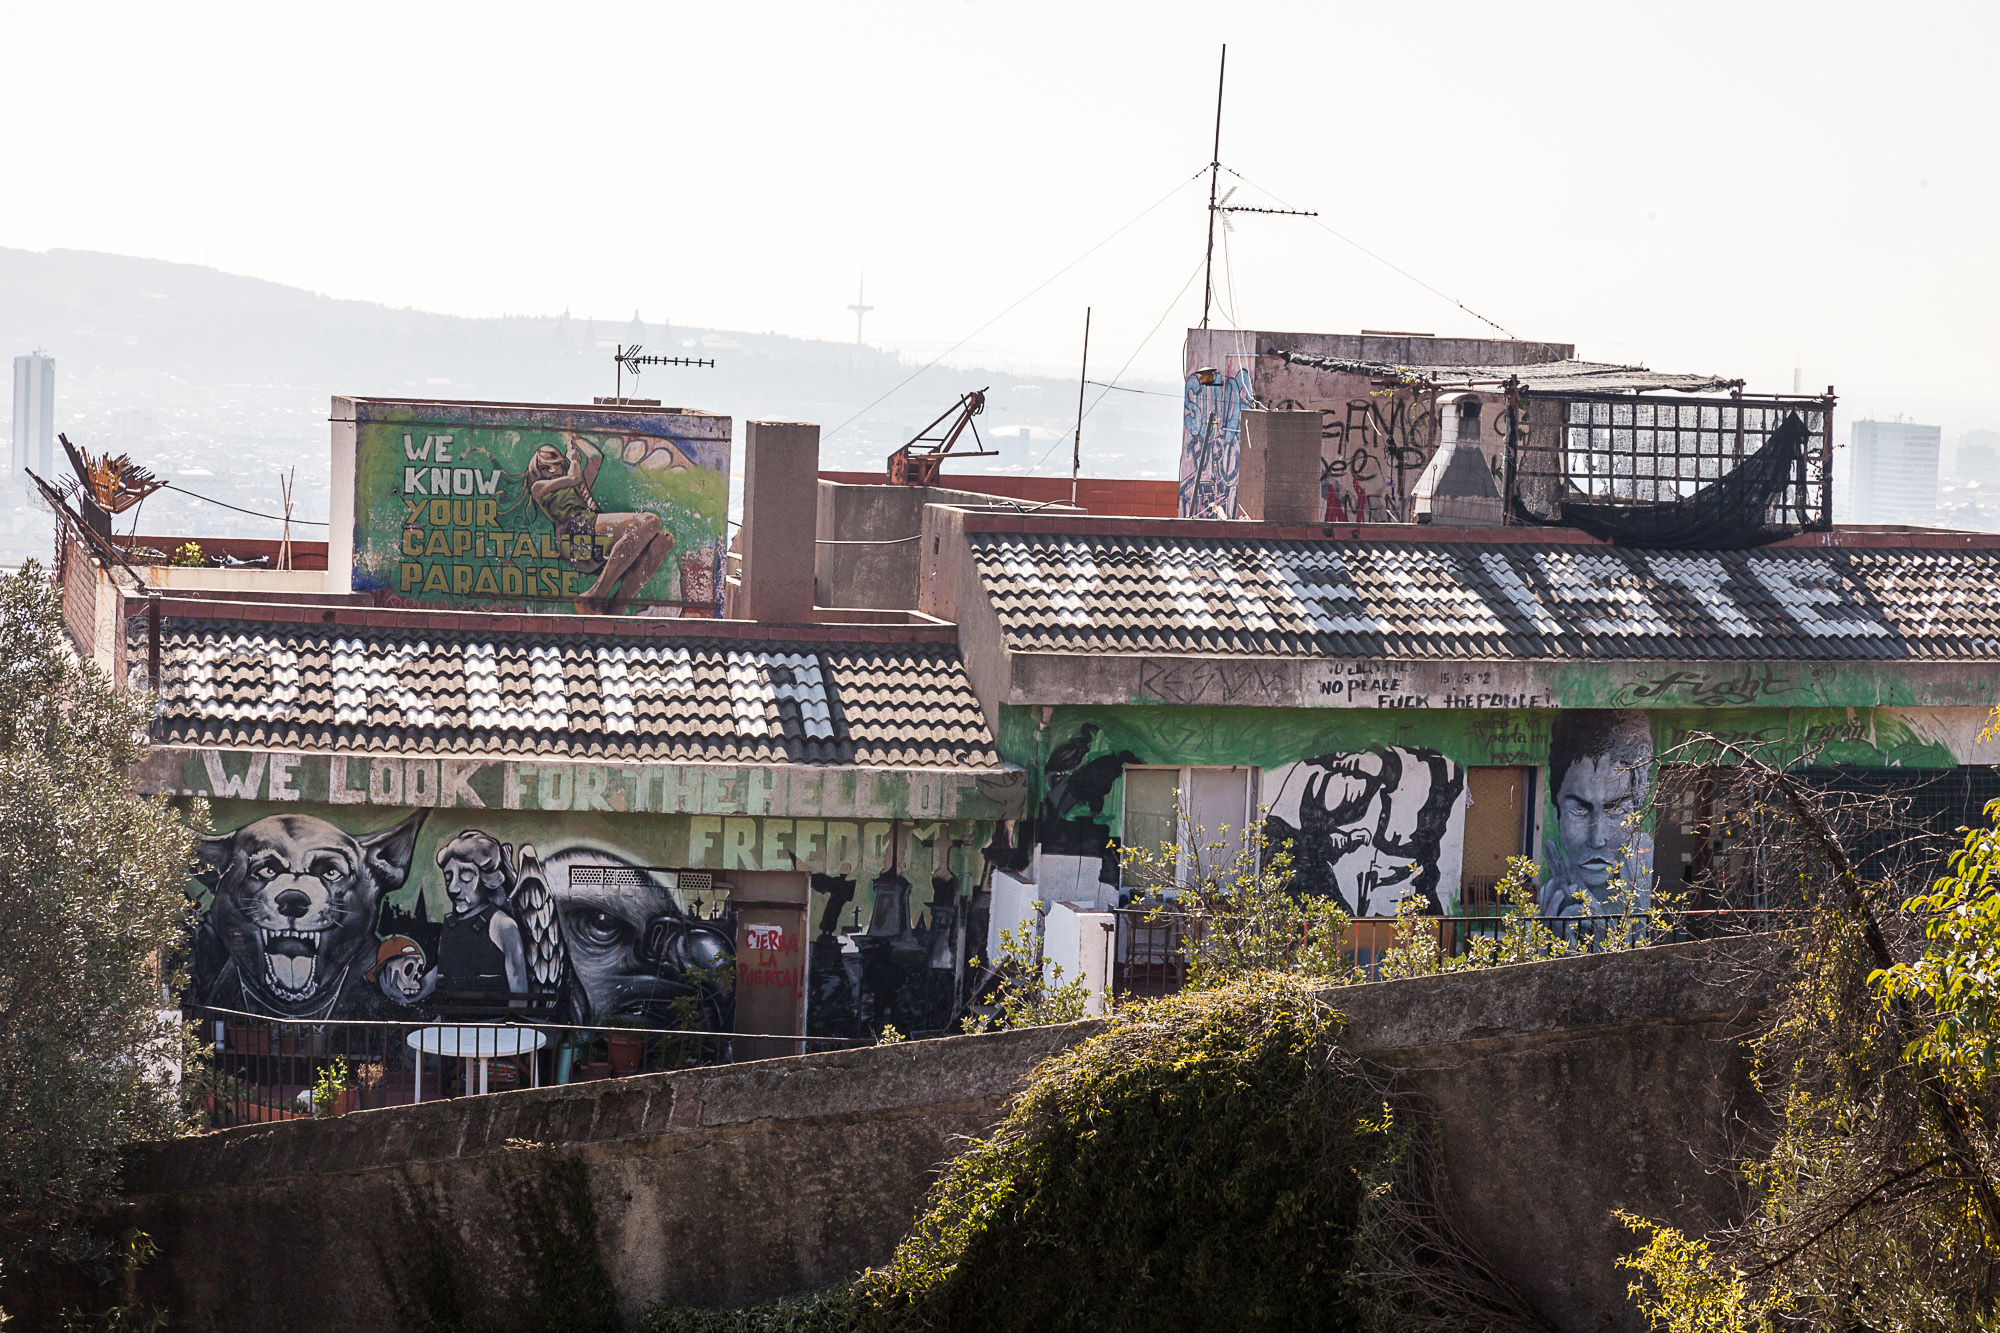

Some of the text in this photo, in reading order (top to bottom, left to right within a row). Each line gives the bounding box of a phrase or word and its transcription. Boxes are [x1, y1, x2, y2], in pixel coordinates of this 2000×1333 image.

[402, 434, 453, 463] WE
[403, 466, 501, 496] KNOW
[401, 498, 501, 528] YOUR
[1319, 679, 1343, 695] NO
[1378, 694, 1430, 709] FUCK
[329, 755, 487, 808] LOOK
[503, 761, 615, 811] FOR
[622, 764, 748, 813] THE
[746, 929, 798, 956] CIERRA
[759, 951, 778, 969] LA
